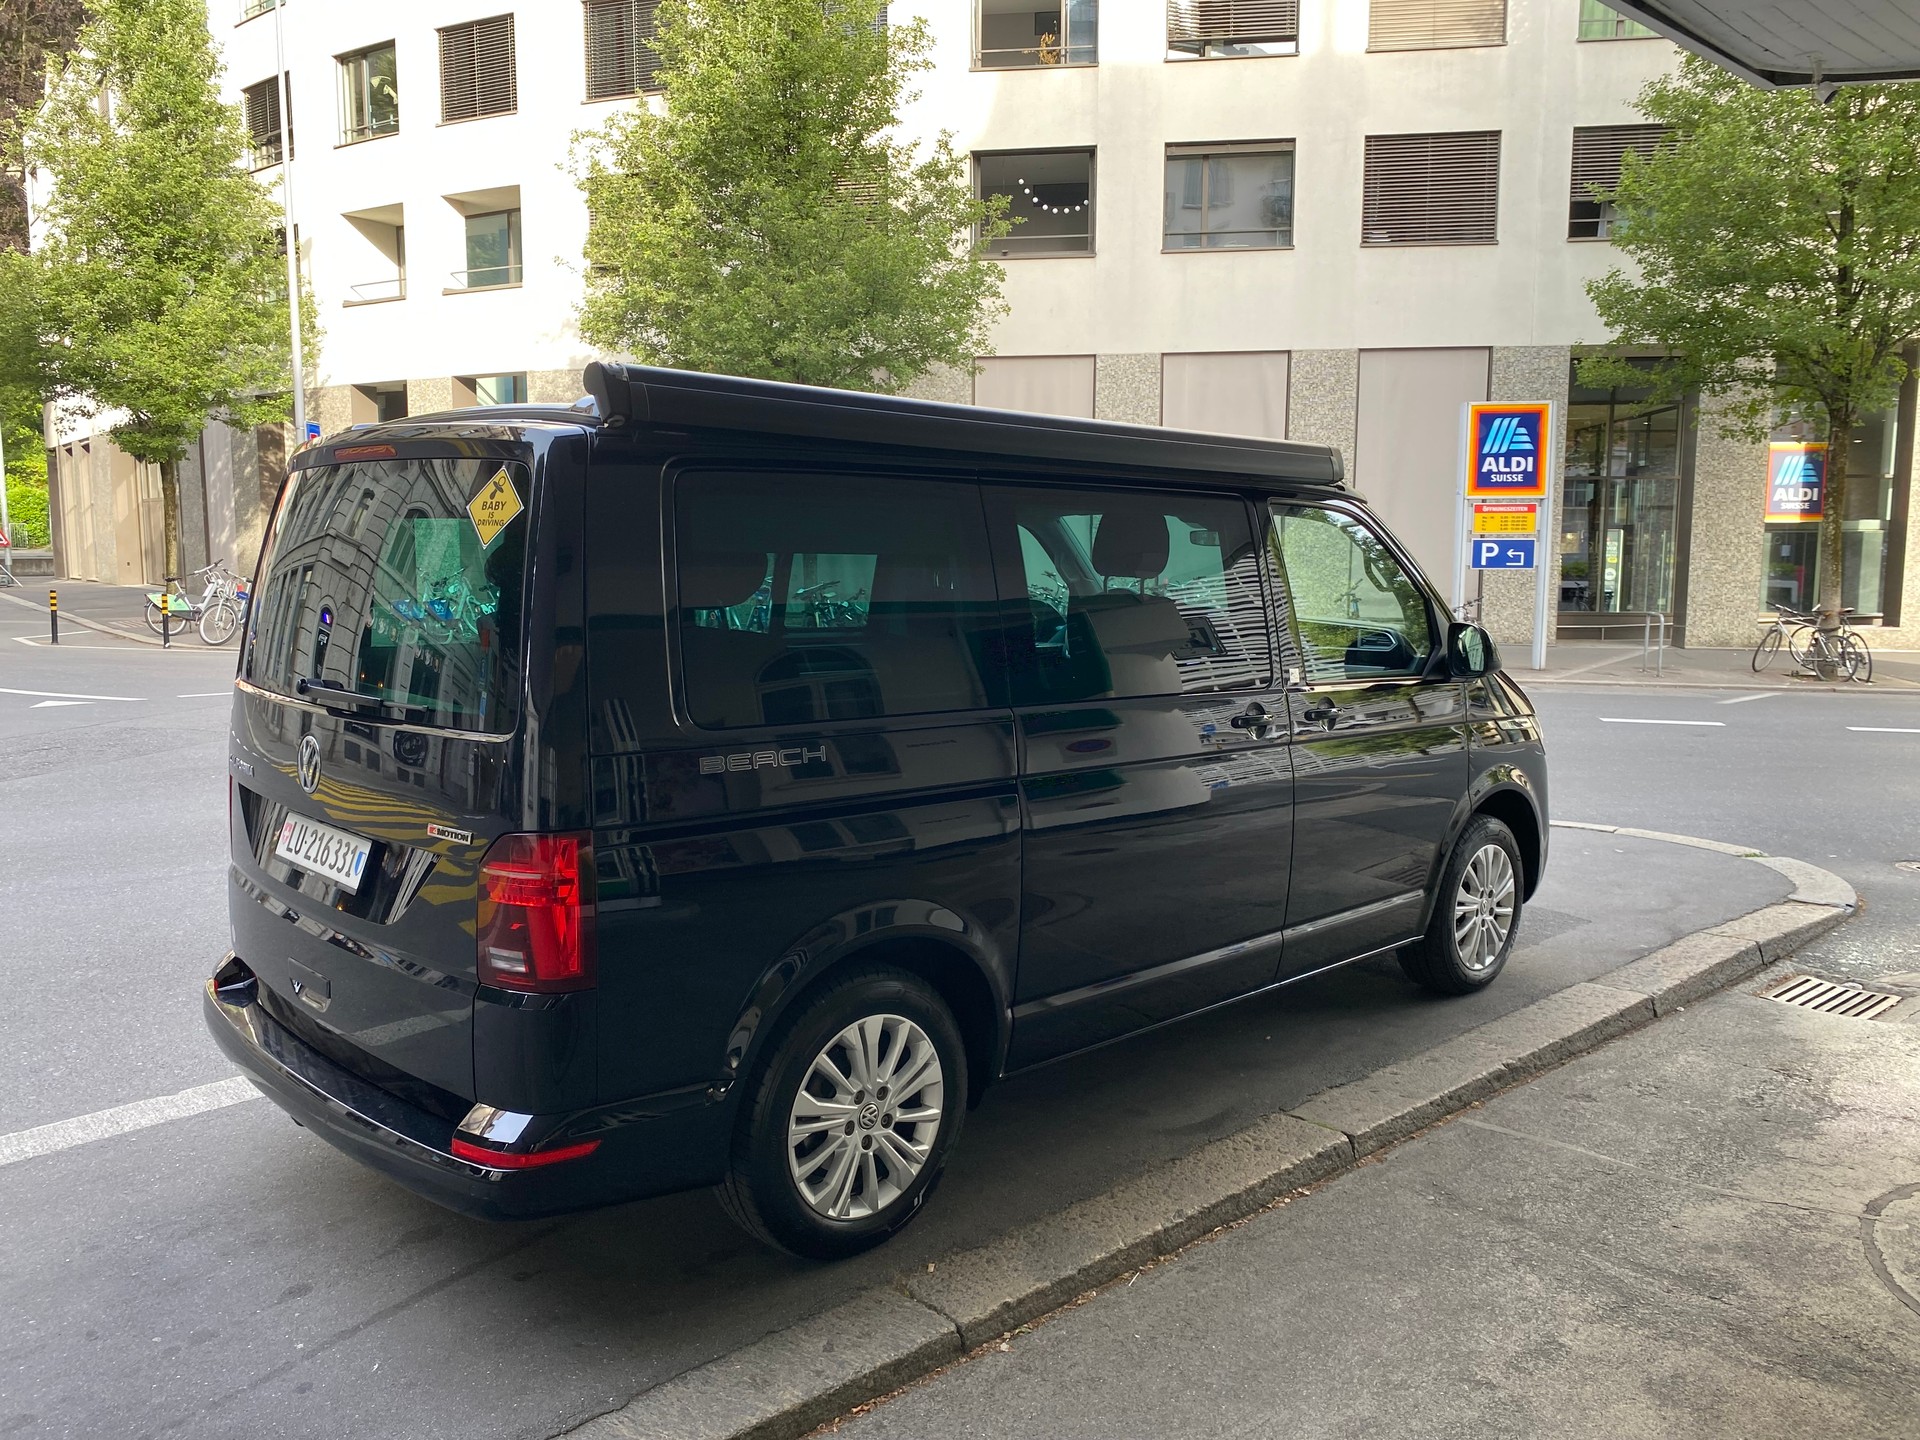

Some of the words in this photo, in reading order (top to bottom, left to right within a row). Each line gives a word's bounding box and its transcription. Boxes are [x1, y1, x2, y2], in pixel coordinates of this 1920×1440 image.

[1481, 457, 1533, 472] ALDI
[1490, 474, 1524, 482] SUISSE
[1773, 488, 1818, 501] ALDI
[481, 501, 507, 510] BABY
[1780, 502, 1810, 510] SUISSE
[1481, 542, 1499, 566] P
[699, 745, 827, 775] BEACH
